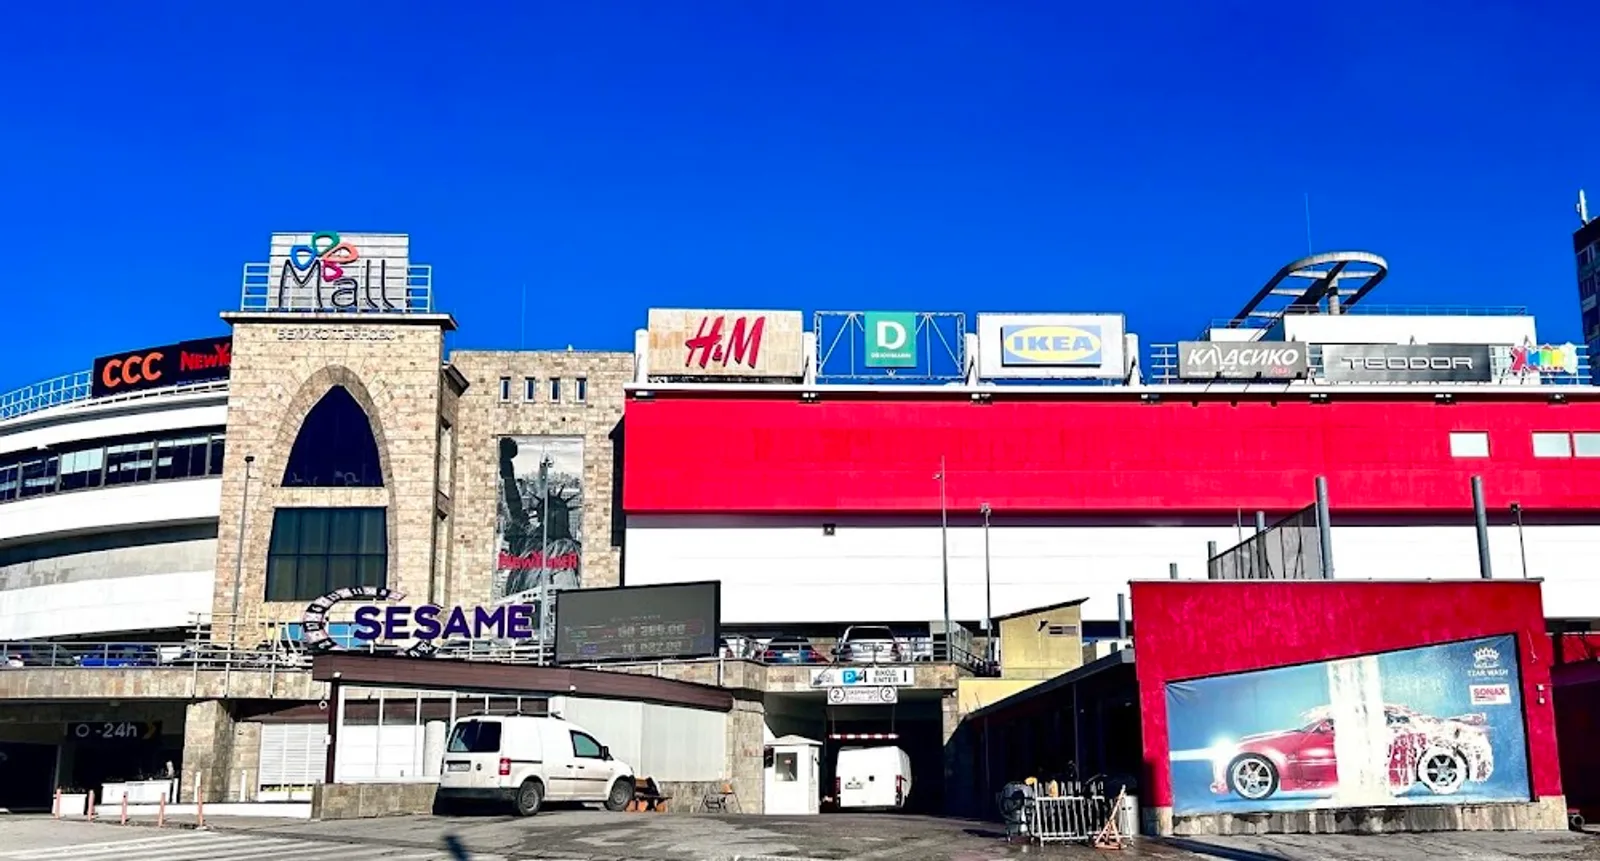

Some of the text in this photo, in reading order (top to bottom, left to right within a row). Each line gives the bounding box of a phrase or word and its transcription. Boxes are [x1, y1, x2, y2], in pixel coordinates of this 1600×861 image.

[278, 258, 395, 308] Mall
[685, 315, 766, 369] H&M
[876, 320, 907, 350] D
[1013, 335, 1093, 351] IKEA
[102, 352, 163, 387] CCC
[1187, 345, 1299, 367] КЛАСИКО
[1341, 356, 1474, 370] TEODOR
[354, 605, 534, 640] SESAME
[1473, 687, 1507, 696] SONAX
